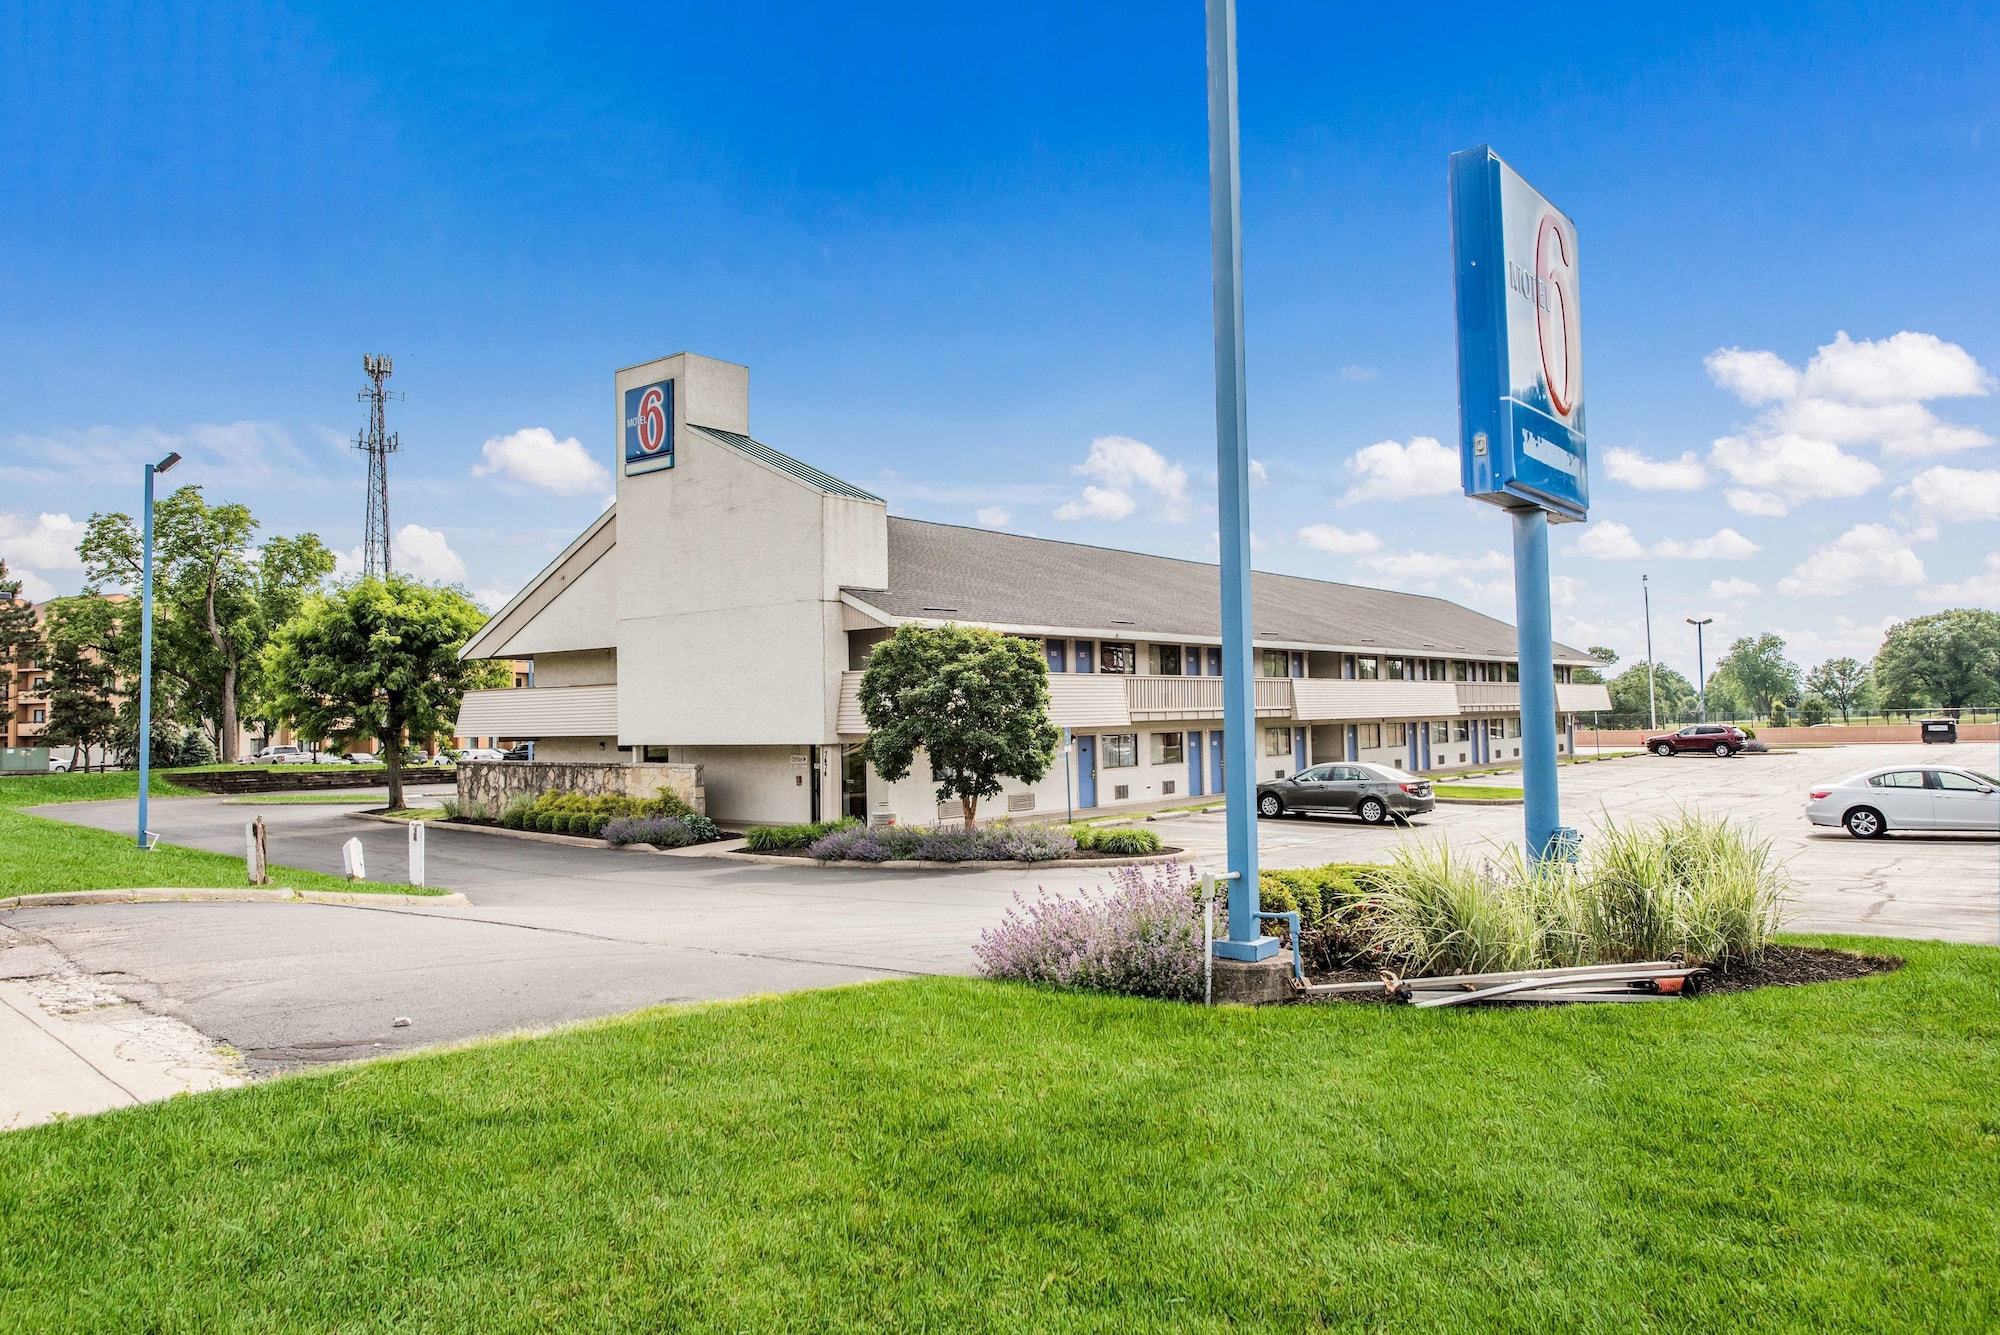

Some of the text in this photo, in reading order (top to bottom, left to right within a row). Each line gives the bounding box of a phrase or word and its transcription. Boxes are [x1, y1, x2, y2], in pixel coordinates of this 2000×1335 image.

[1509, 213, 1575, 416] MOTEL 6
[627, 388, 665, 452] MOTEL 6
